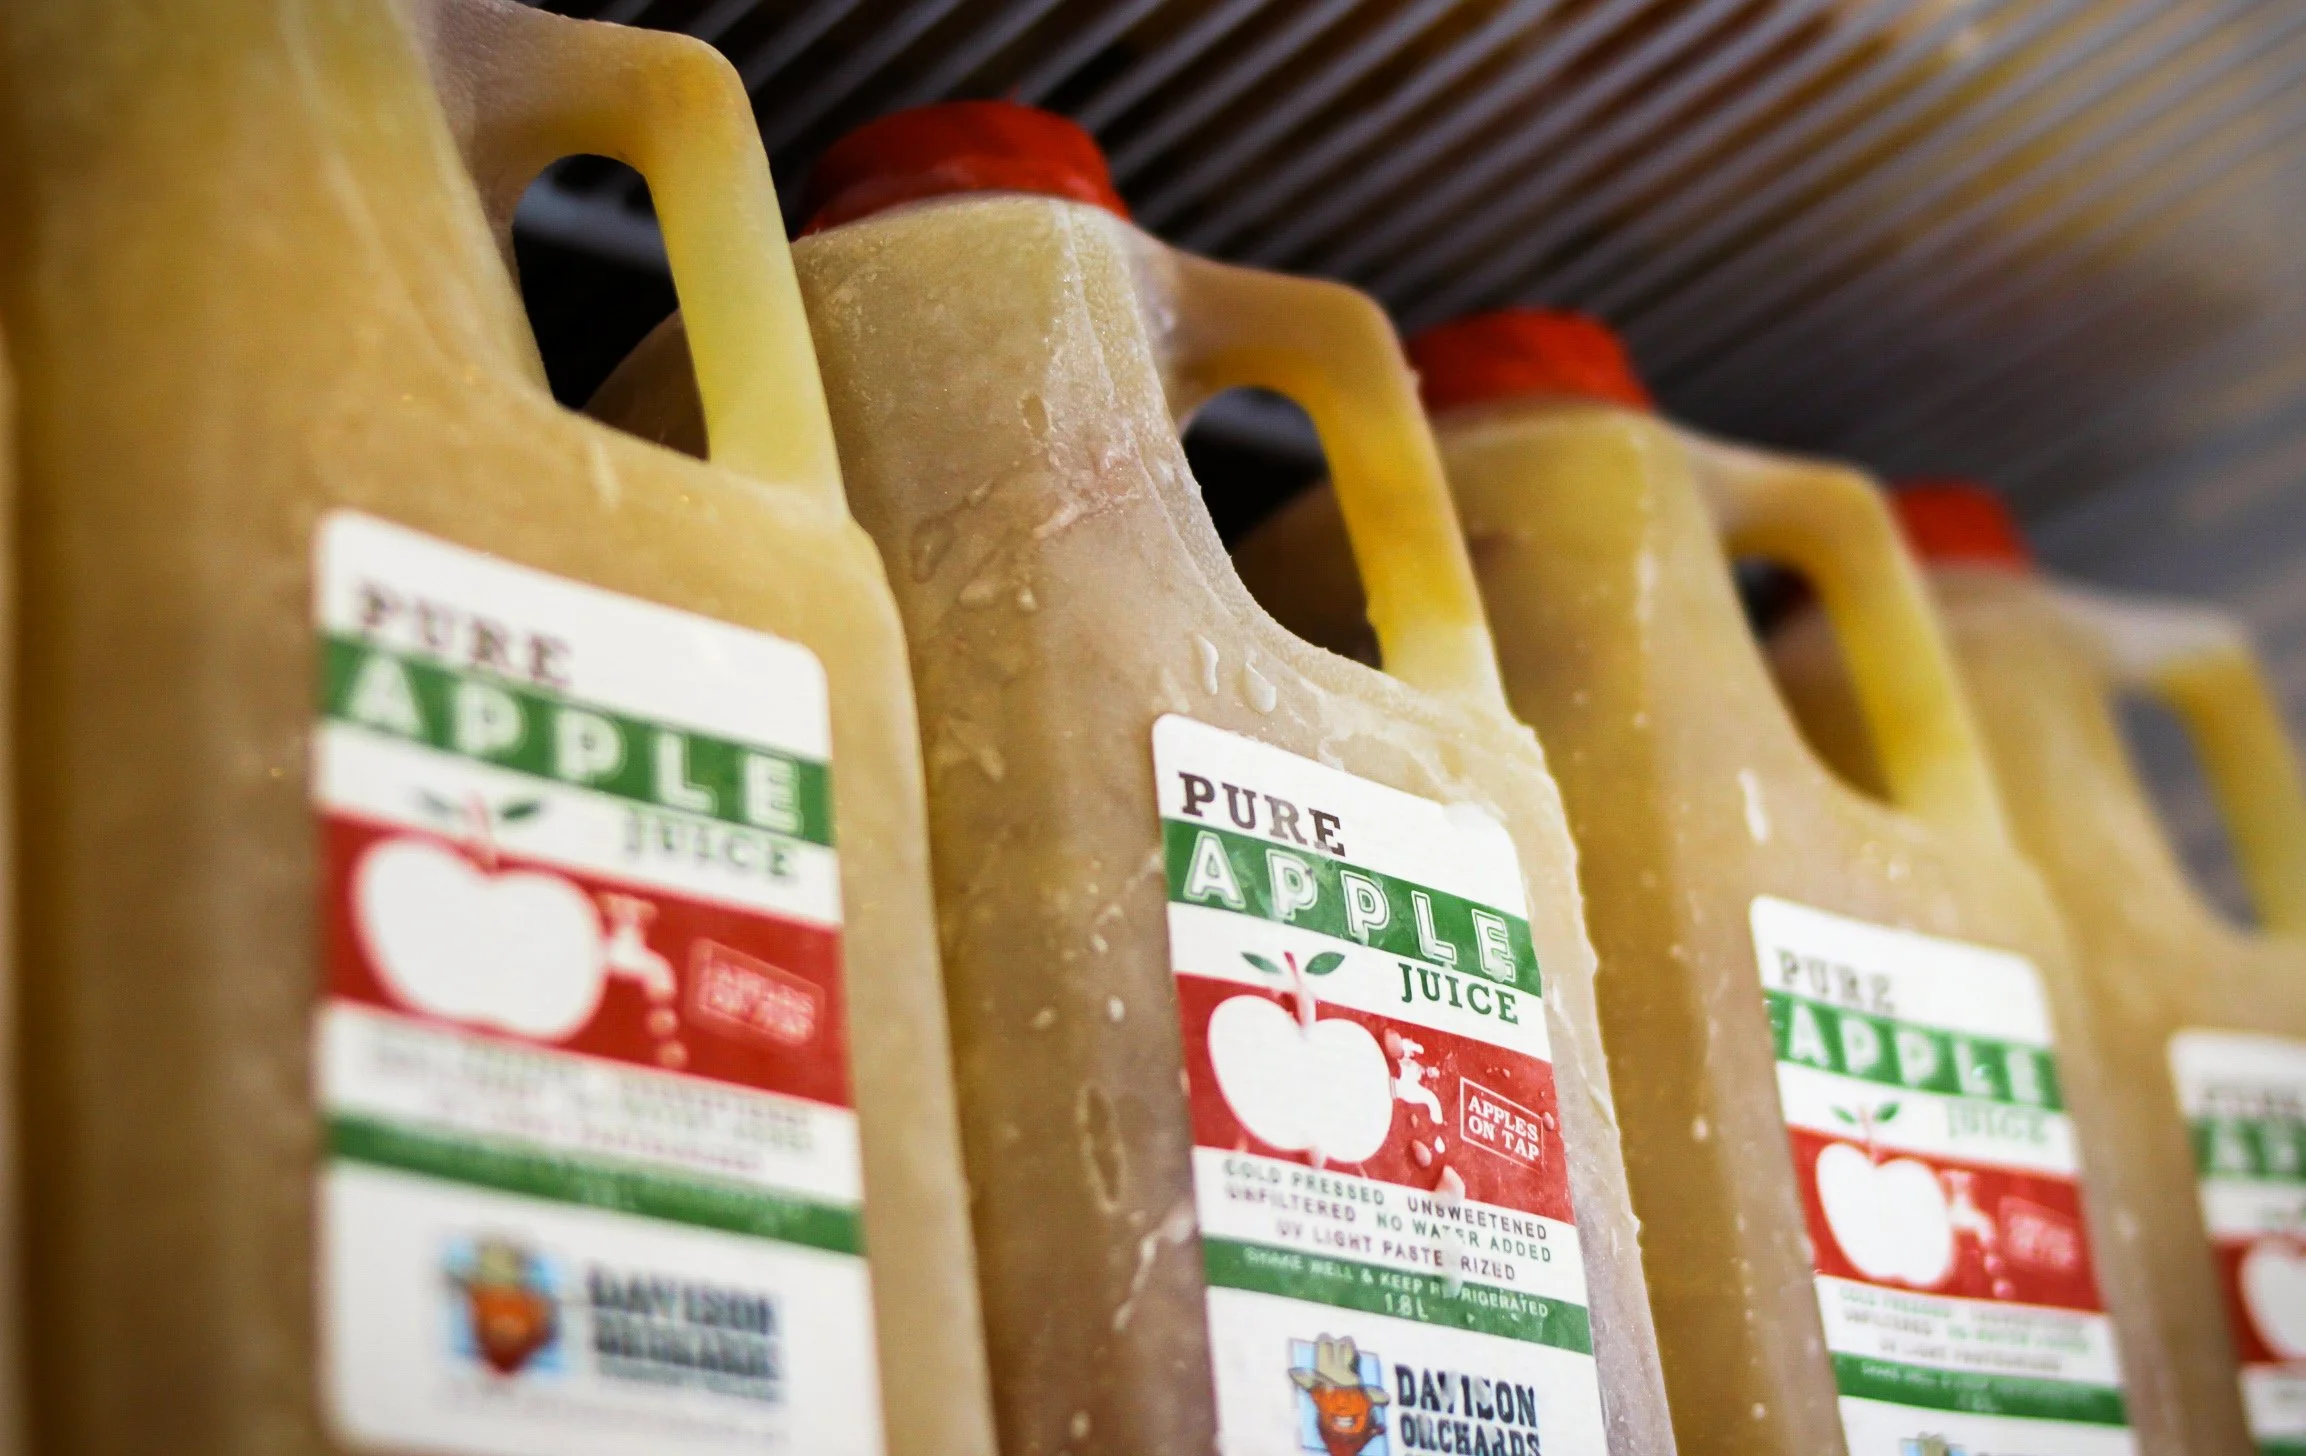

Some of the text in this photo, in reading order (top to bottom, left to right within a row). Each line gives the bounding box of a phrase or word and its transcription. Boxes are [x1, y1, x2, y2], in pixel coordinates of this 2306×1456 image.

[357, 583, 572, 690] PURE
[347, 652, 804, 833] APPLE
[623, 805, 797, 877] JUICE
[1178, 771, 1345, 857] PURE
[1183, 831, 1516, 982] APPLE
[1398, 962, 1519, 1025] JUICE
[1776, 948, 1895, 1014] PURE
[1787, 1001, 2043, 1104] APPLE
[1468, 1095, 1539, 1142] APPLES
[1468, 1115, 1540, 1161] ON TAP
[1223, 1158, 1547, 1241] COLD PRESSED UNSWEETENED
[1226, 1184, 1356, 1223] UNFILTERED
[1376, 1212, 1402, 1231] NO
[1490, 1235, 1551, 1263] ADDED
[1277, 1220, 1516, 1281] UV LIGHT PASTERIZED
[1380, 1271, 1424, 1294] KEEP
[1430, 1281, 1549, 1318] RRIGERATED
